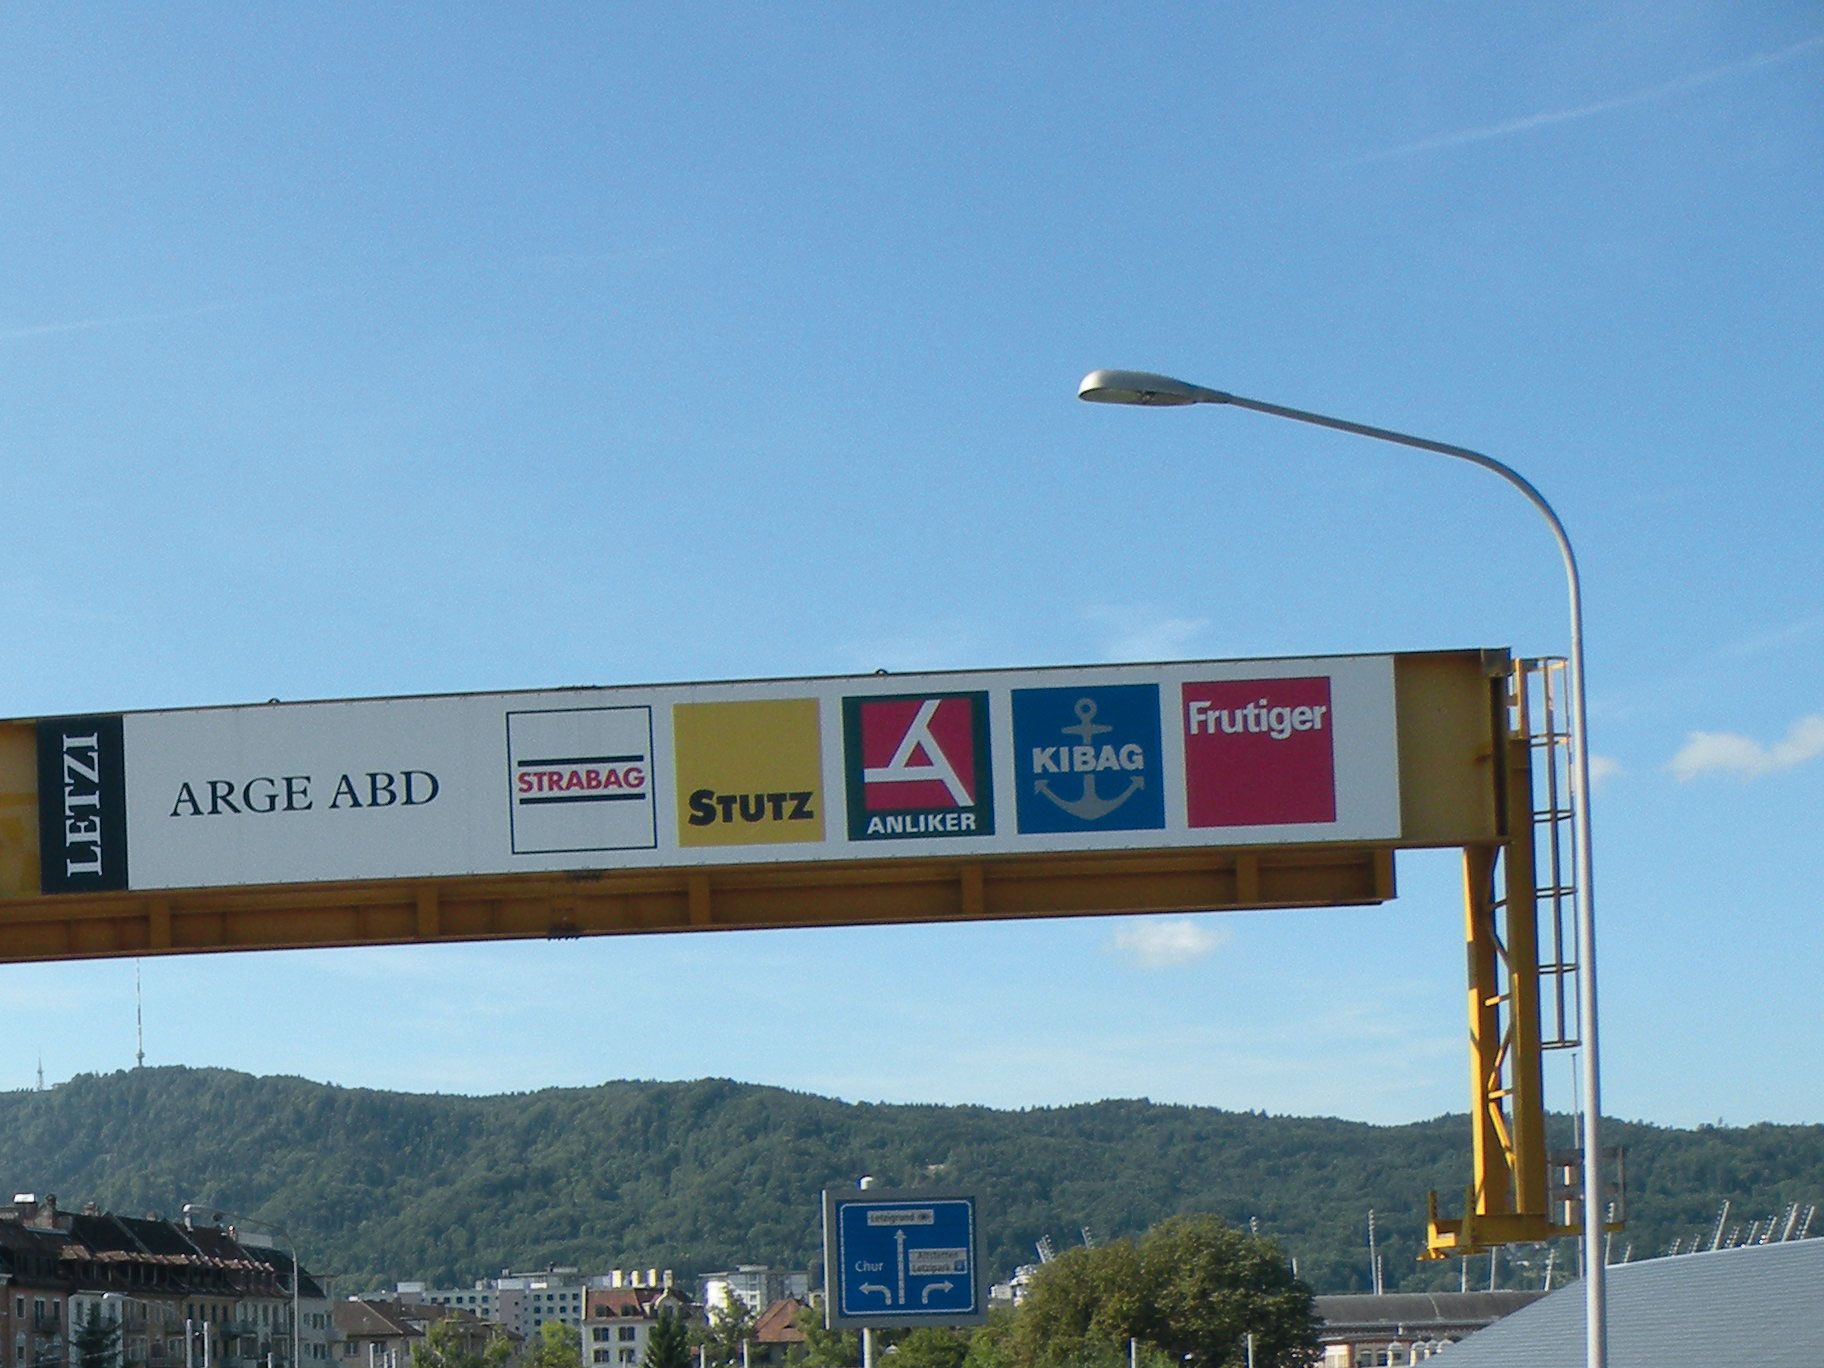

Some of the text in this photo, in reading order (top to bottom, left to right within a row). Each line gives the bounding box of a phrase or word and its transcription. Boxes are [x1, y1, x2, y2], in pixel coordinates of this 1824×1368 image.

[1188, 698, 1327, 740] Frutiger
[1032, 743, 1145, 774] KIBAG
[169, 770, 440, 817] ARGE ABD
[517, 767, 645, 793] STRABAG
[63, 732, 103, 878] LETZI
[688, 789, 814, 826] STUTZ
[867, 812, 976, 835] ANLIKER
[855, 1260, 884, 1272] Chur
